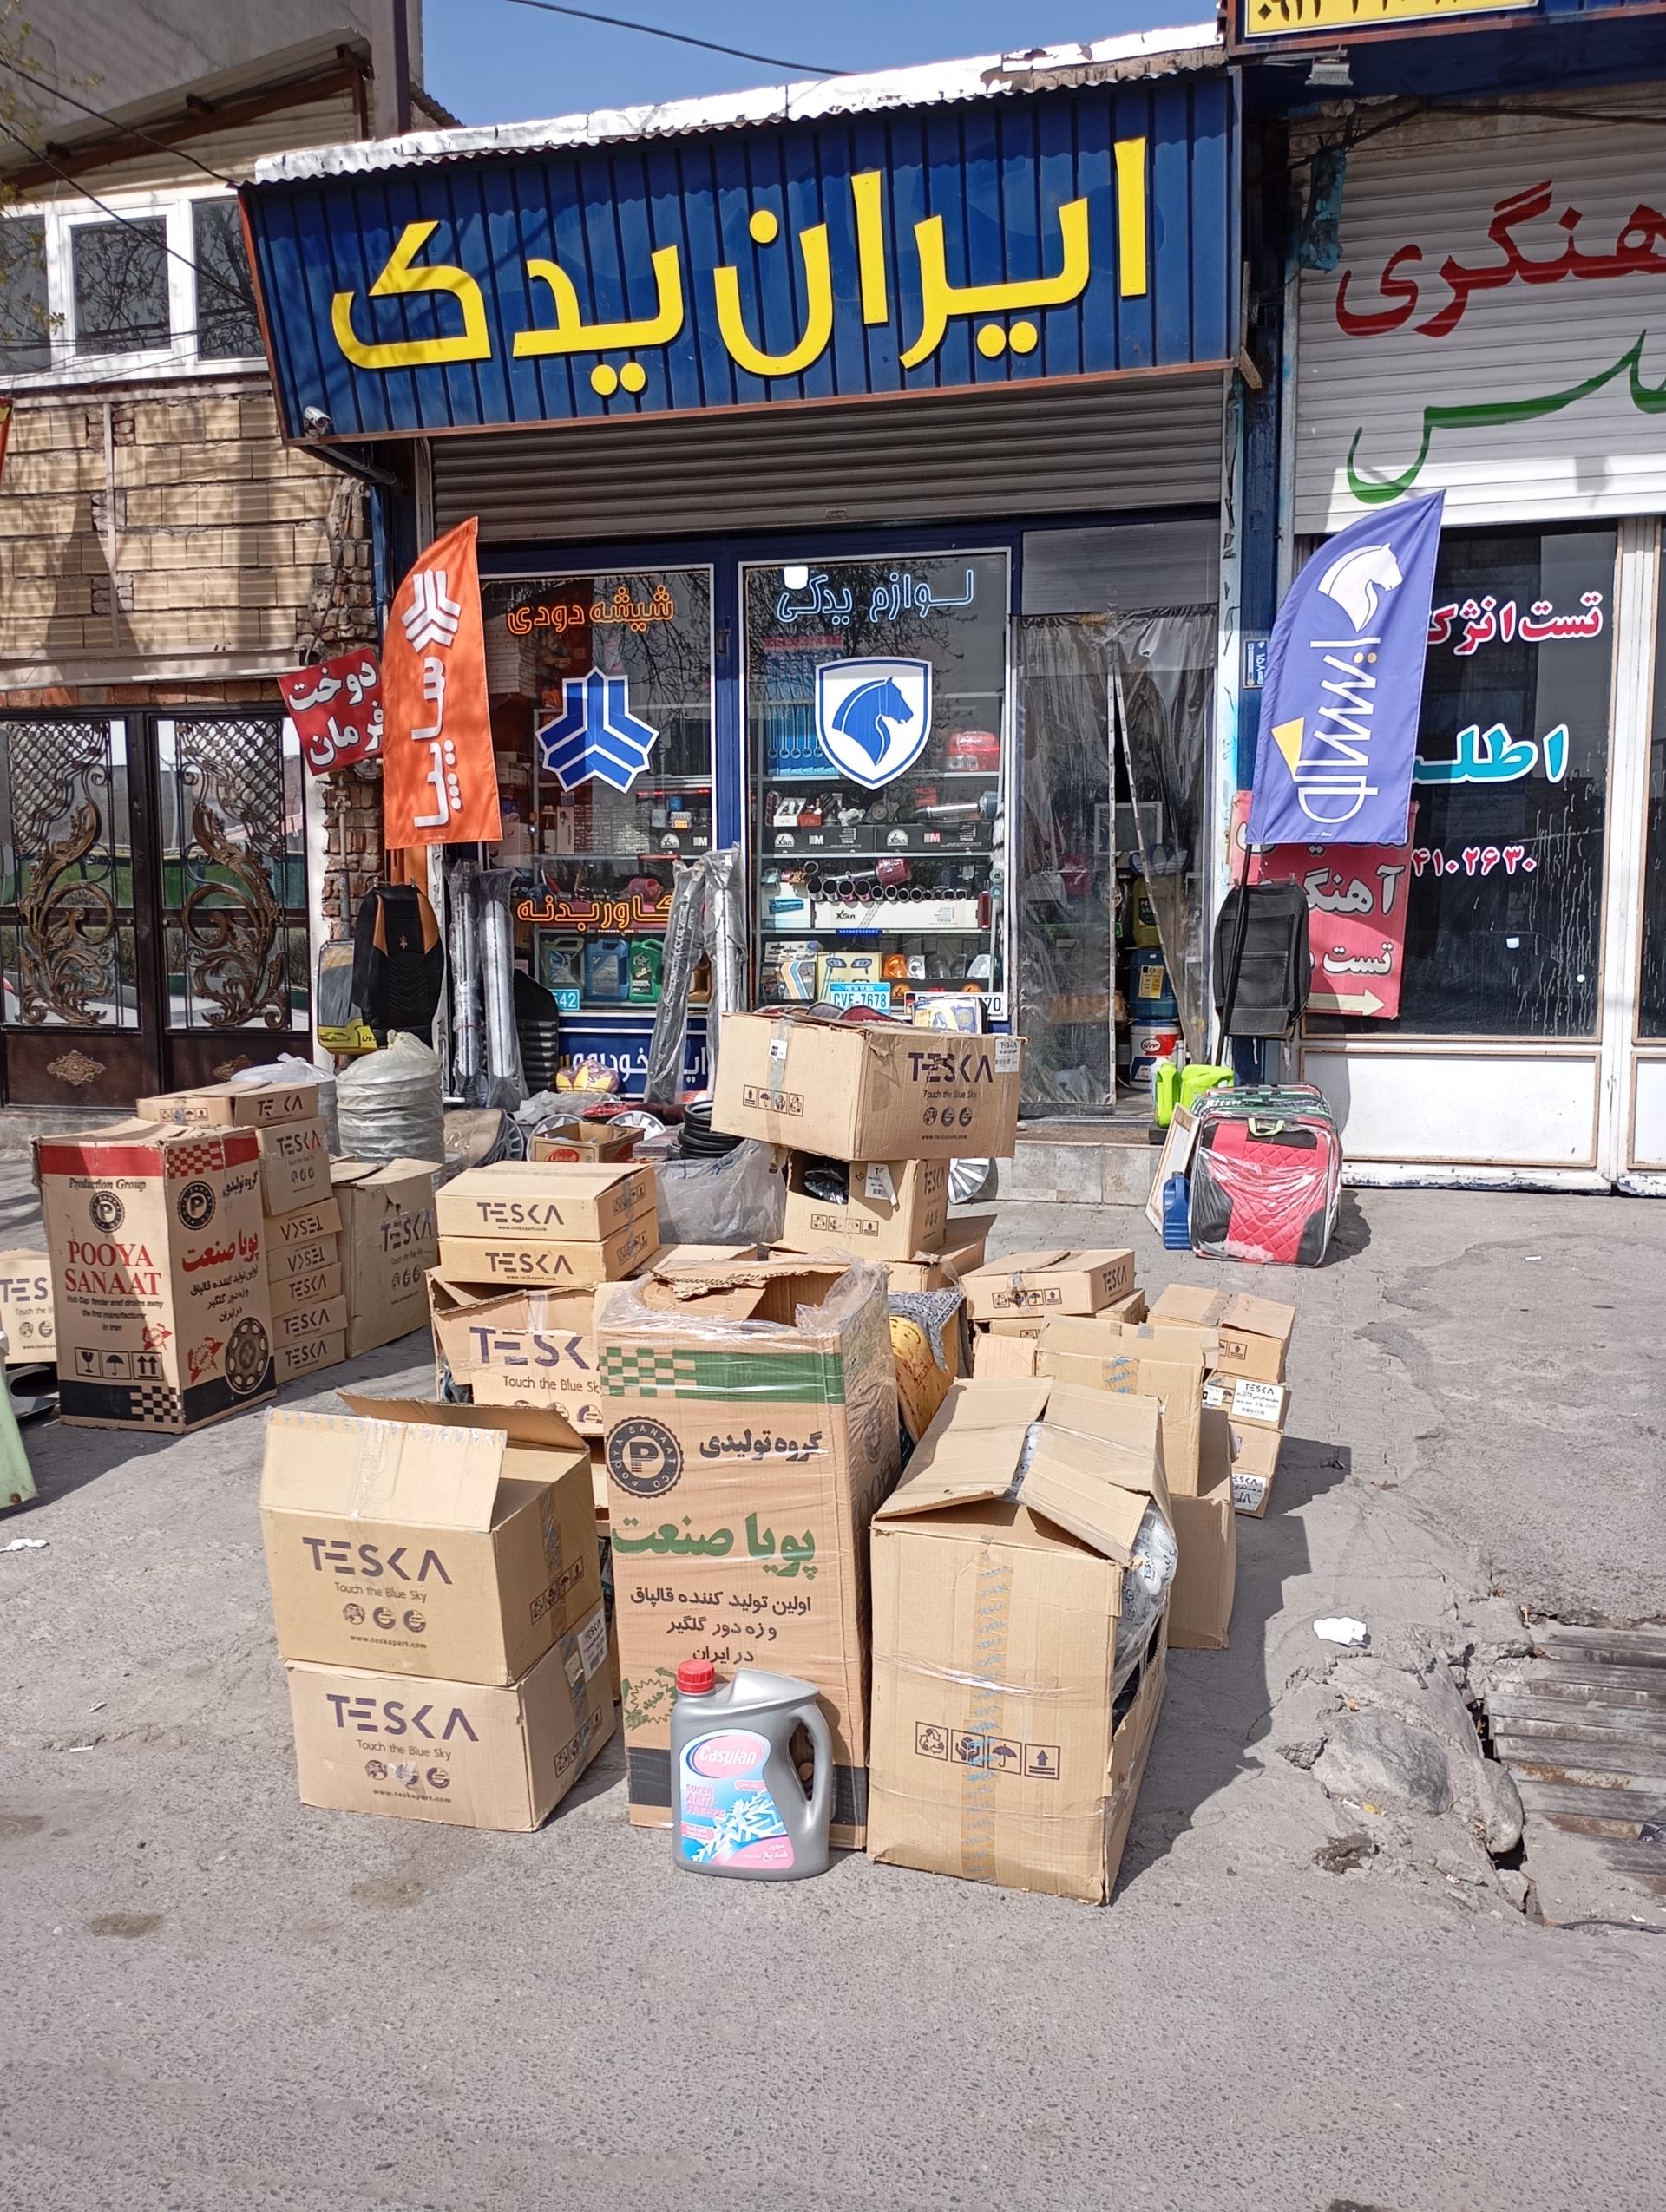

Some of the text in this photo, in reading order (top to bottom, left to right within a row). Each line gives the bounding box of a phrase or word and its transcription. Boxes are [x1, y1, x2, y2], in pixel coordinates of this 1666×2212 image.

[331, 136, 1146, 396] ایران یدک
[508, 584, 674, 635] شیشه دودی
[777, 569, 974, 625] لوازم یدکی
[1519, 591, 1603, 641] تست
[288, 661, 377, 710] دوخت
[1413, 723, 1569, 783] اطل
[517, 894, 600, 932] بدنه
[1322, 942, 1393, 975] تست
[908, 1052, 993, 1083] TESKA
[277, 1130, 320, 1156] TESKA
[116, 1179, 146, 1192] Group
[477, 1202, 564, 1225] TESKA
[68, 1240, 154, 1266] POOYA
[181, 1240, 236, 1273] صنعت
[485, 1252, 574, 1275] TESKA
[65, 1268, 161, 1295] SANAAT
[289, 1274, 327, 1299] TESKA
[284, 1309, 330, 1334] TESKA
[285, 1341, 327, 1367] TESKA
[469, 1326, 600, 1371] TESK
[503, 1376, 535, 1388] Touch
[540, 1378, 556, 1389] the
[561, 1378, 583, 1391] Blue
[699, 1428, 823, 1461] گروه تولیدی
[1232, 1475, 1257, 1485] ESKA
[612, 1512, 818, 1581] پویا صنعت
[302, 1536, 453, 1585] TESKA
[335, 1582, 427, 1603] Touch the Blue Sky
[630, 1587, 810, 1615] اولین تولید کننده قالپاق
[666, 1615, 707, 1634] گلگیر
[712, 1622, 741, 1638] دور
[350, 1635, 427, 1649] www.teskapart.com
[733, 1650, 754, 1664] در
[326, 1693, 479, 1742] TESKA
[357, 1739, 451, 1762] Touch the Blue Sky
[699, 1745, 758, 1767] Caspian
